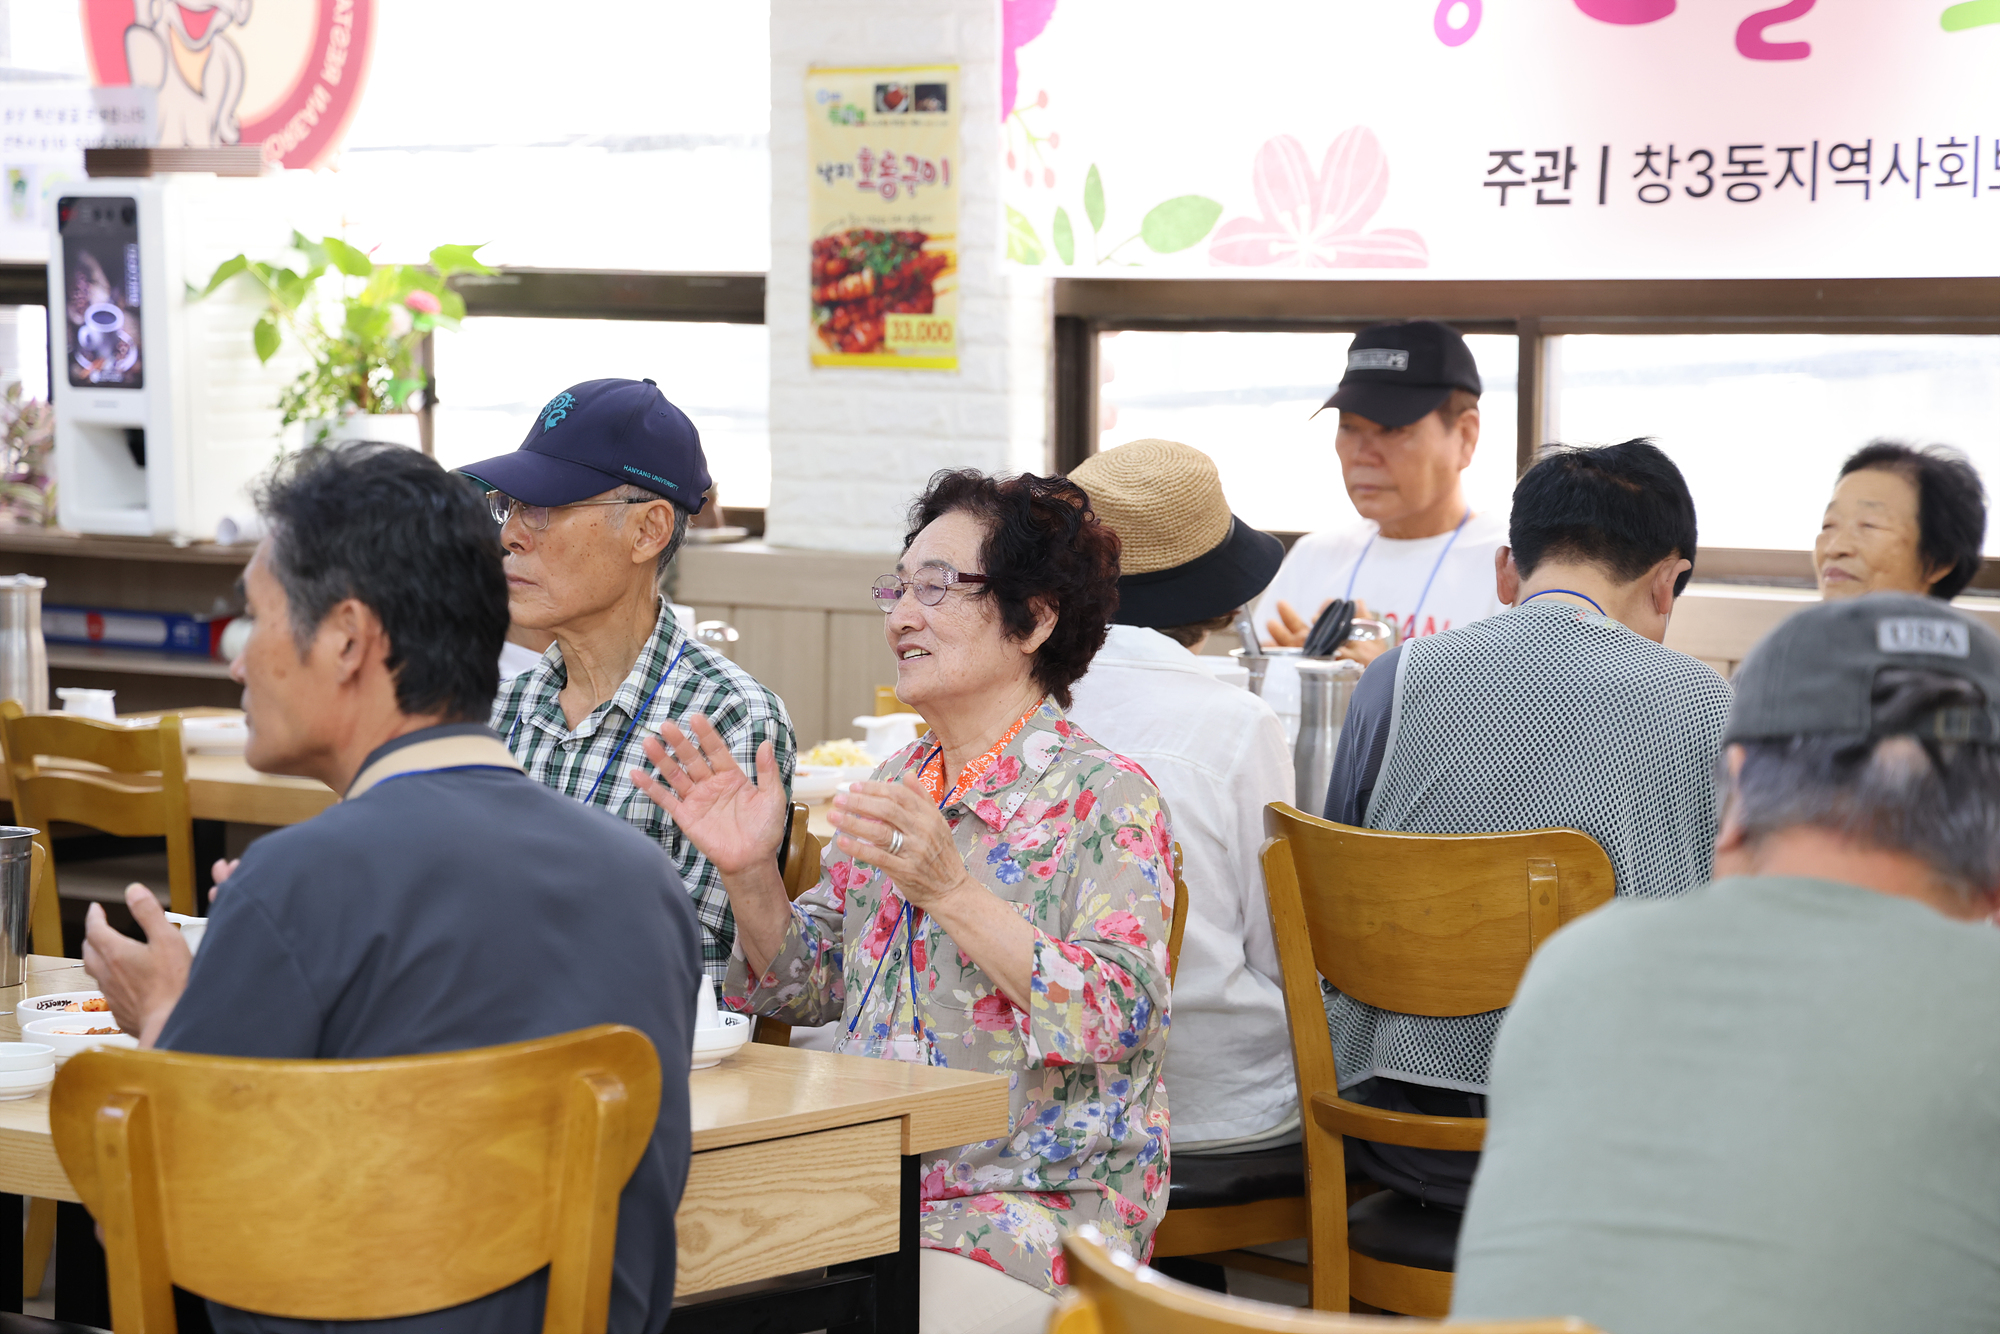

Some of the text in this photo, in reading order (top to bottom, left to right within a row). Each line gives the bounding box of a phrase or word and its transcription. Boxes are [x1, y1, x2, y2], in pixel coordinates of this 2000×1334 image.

[857, 146, 951, 200] 호롱구이
[1483, 146, 1577, 206] 주관
[624, 465, 679, 491] HANYANG UNIVERSITY
